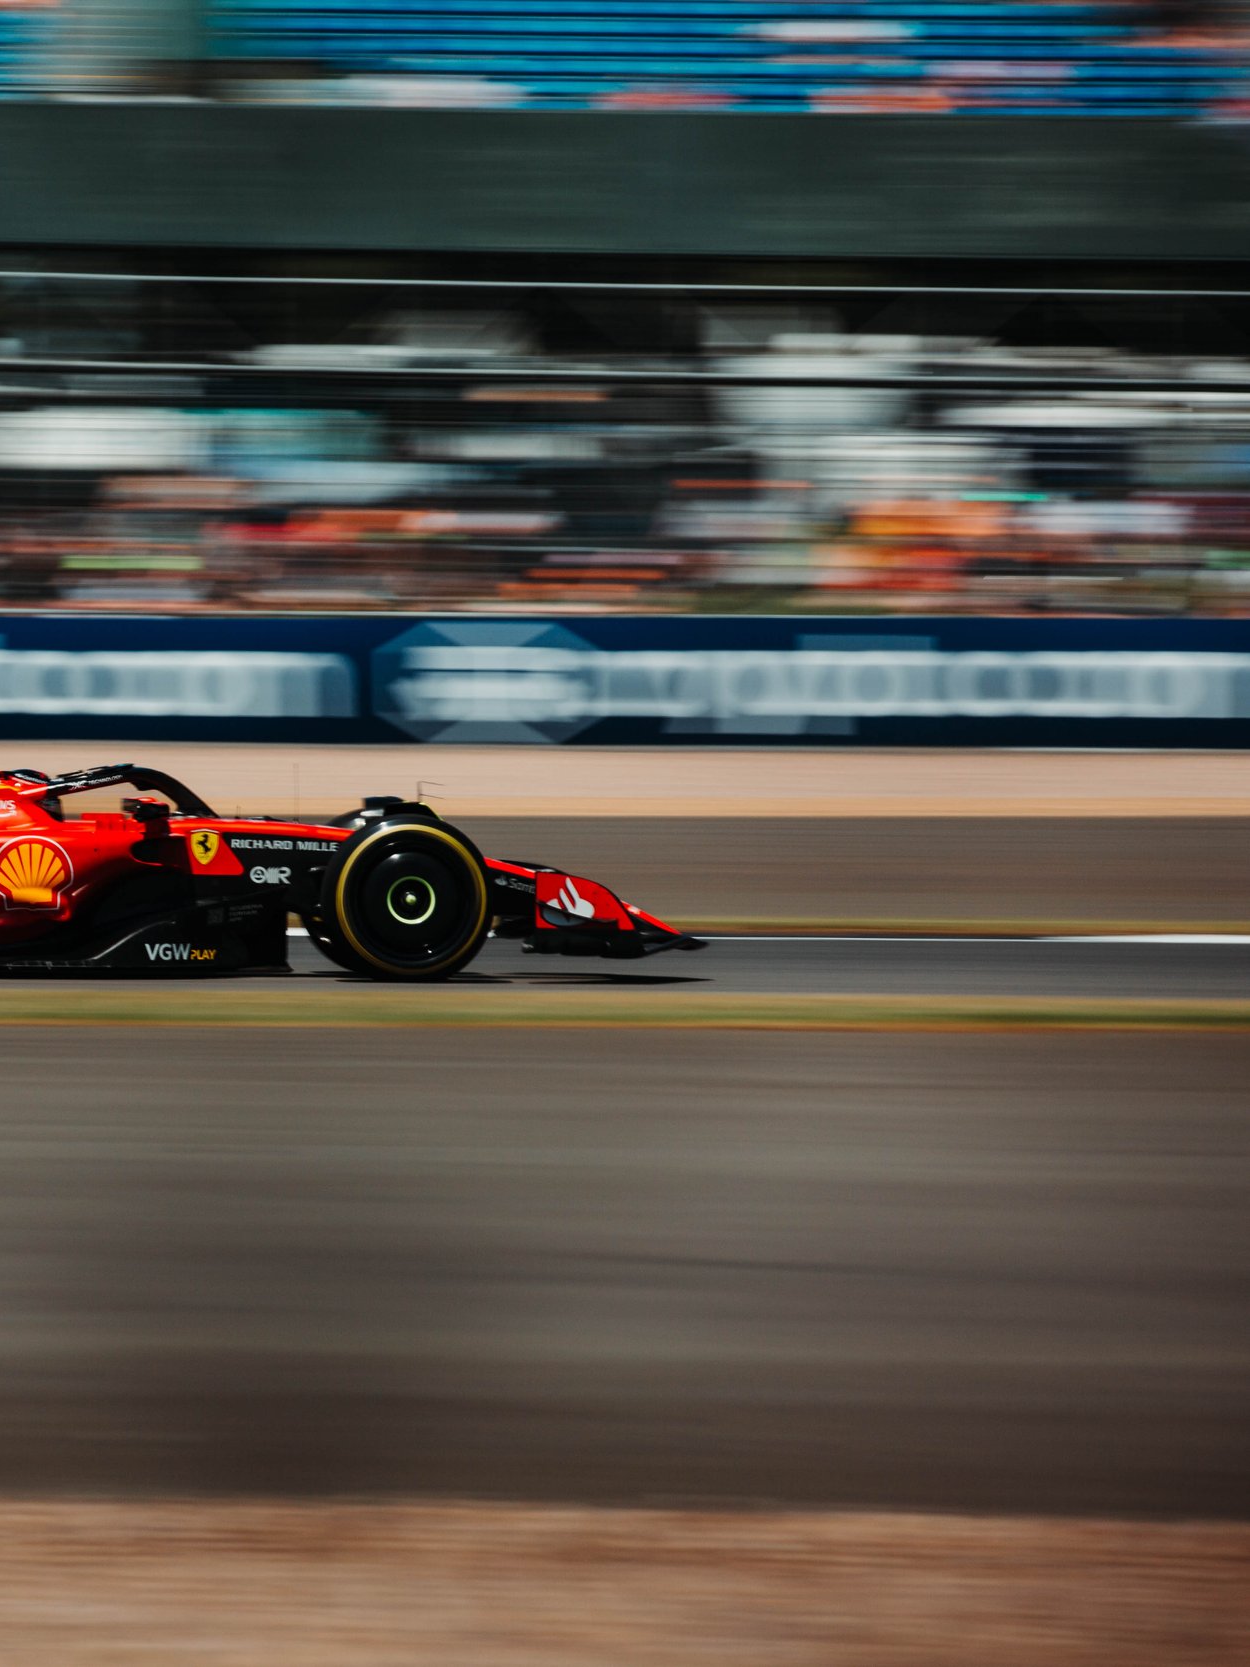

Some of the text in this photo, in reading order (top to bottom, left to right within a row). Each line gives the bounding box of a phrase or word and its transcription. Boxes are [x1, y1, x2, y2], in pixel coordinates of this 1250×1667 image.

[230, 838, 339, 852] RICHARD MILLE
[144, 943, 216, 961] VGW PLAY
